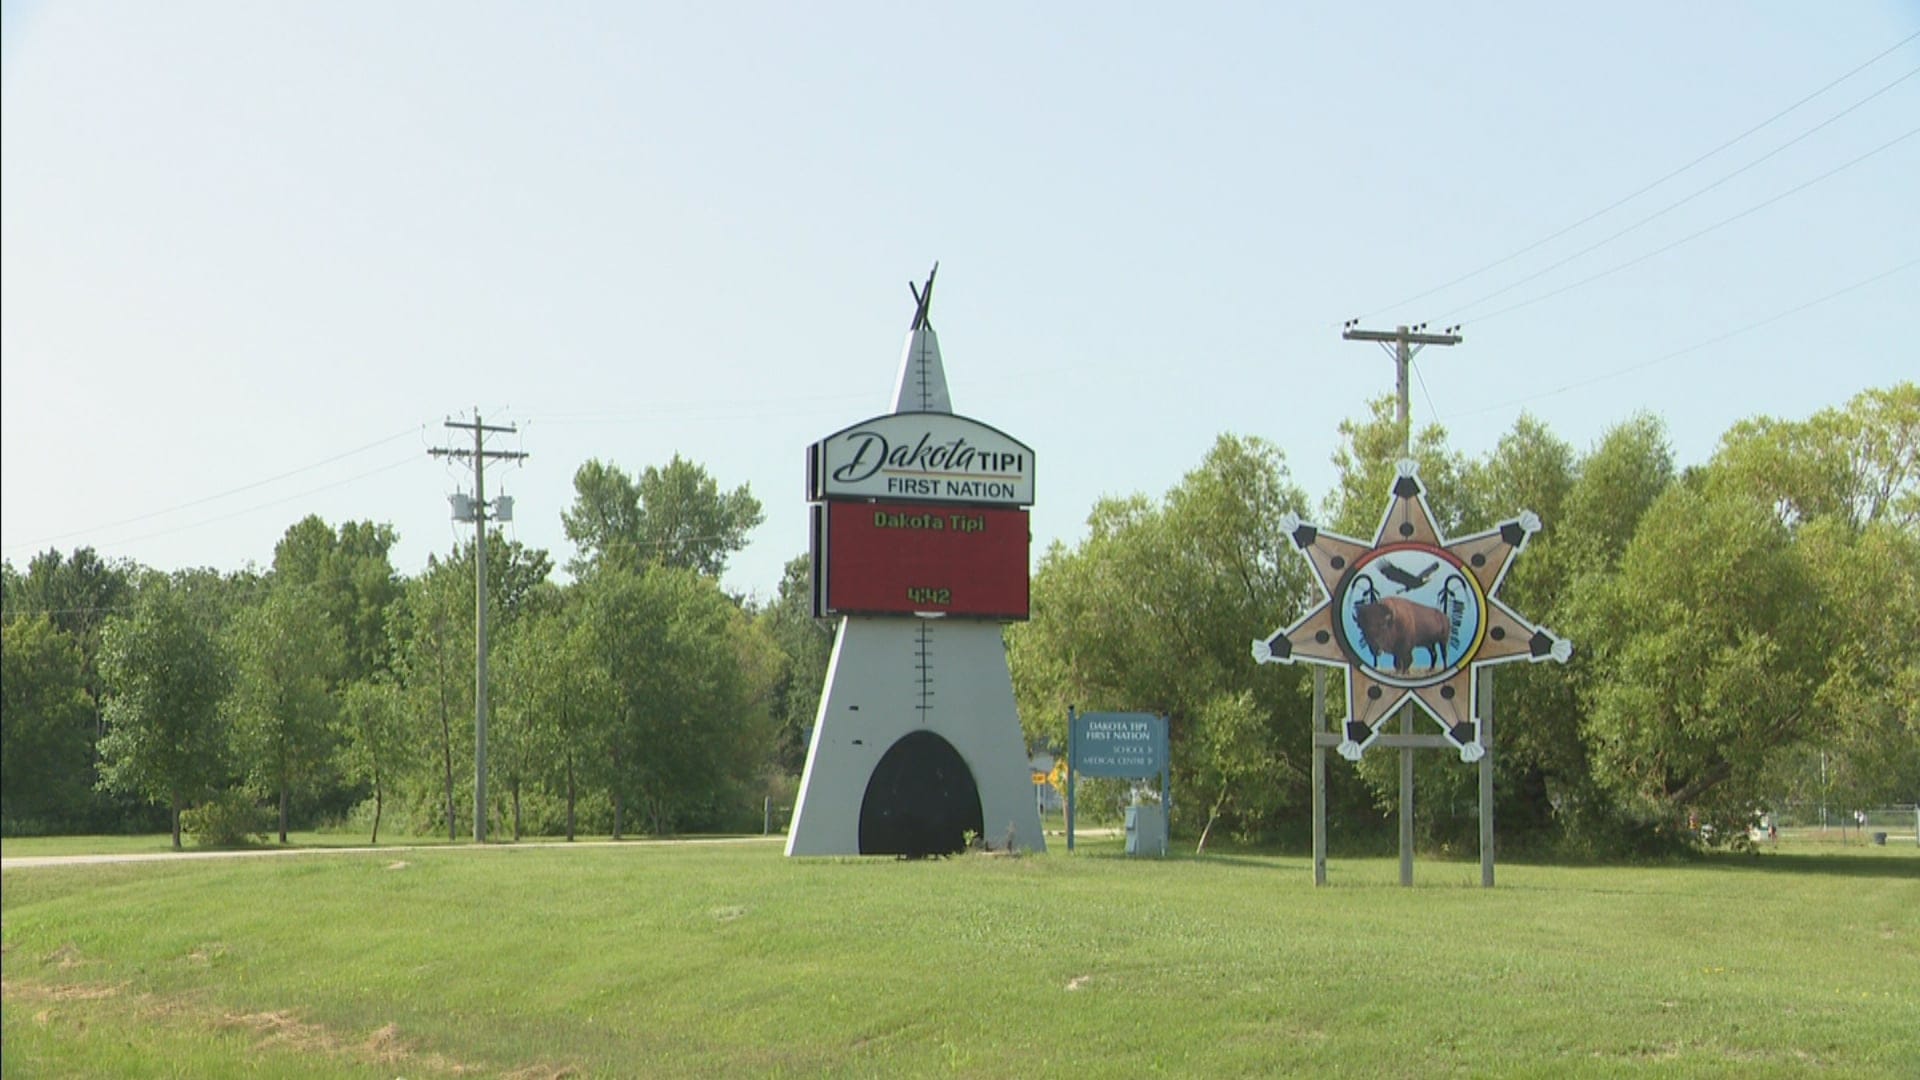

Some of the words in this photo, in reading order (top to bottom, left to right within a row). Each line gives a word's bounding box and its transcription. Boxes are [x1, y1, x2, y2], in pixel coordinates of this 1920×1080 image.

[832, 431, 976, 483] Dakota
[977, 451, 1023, 473] TIPI
[888, 477, 941, 496] FIRST
[946, 481, 1015, 499] NATION
[874, 511, 944, 530] Dakota
[949, 514, 984, 533] Tipi
[907, 587, 951, 604] 4:42
[1089, 721, 1128, 731] DAKOTA
[1130, 721, 1148, 731] TIPI
[1086, 731, 1112, 740] FIRST
[1113, 731, 1150, 740] NATION
[1083, 757, 1115, 765] MEDICAL
